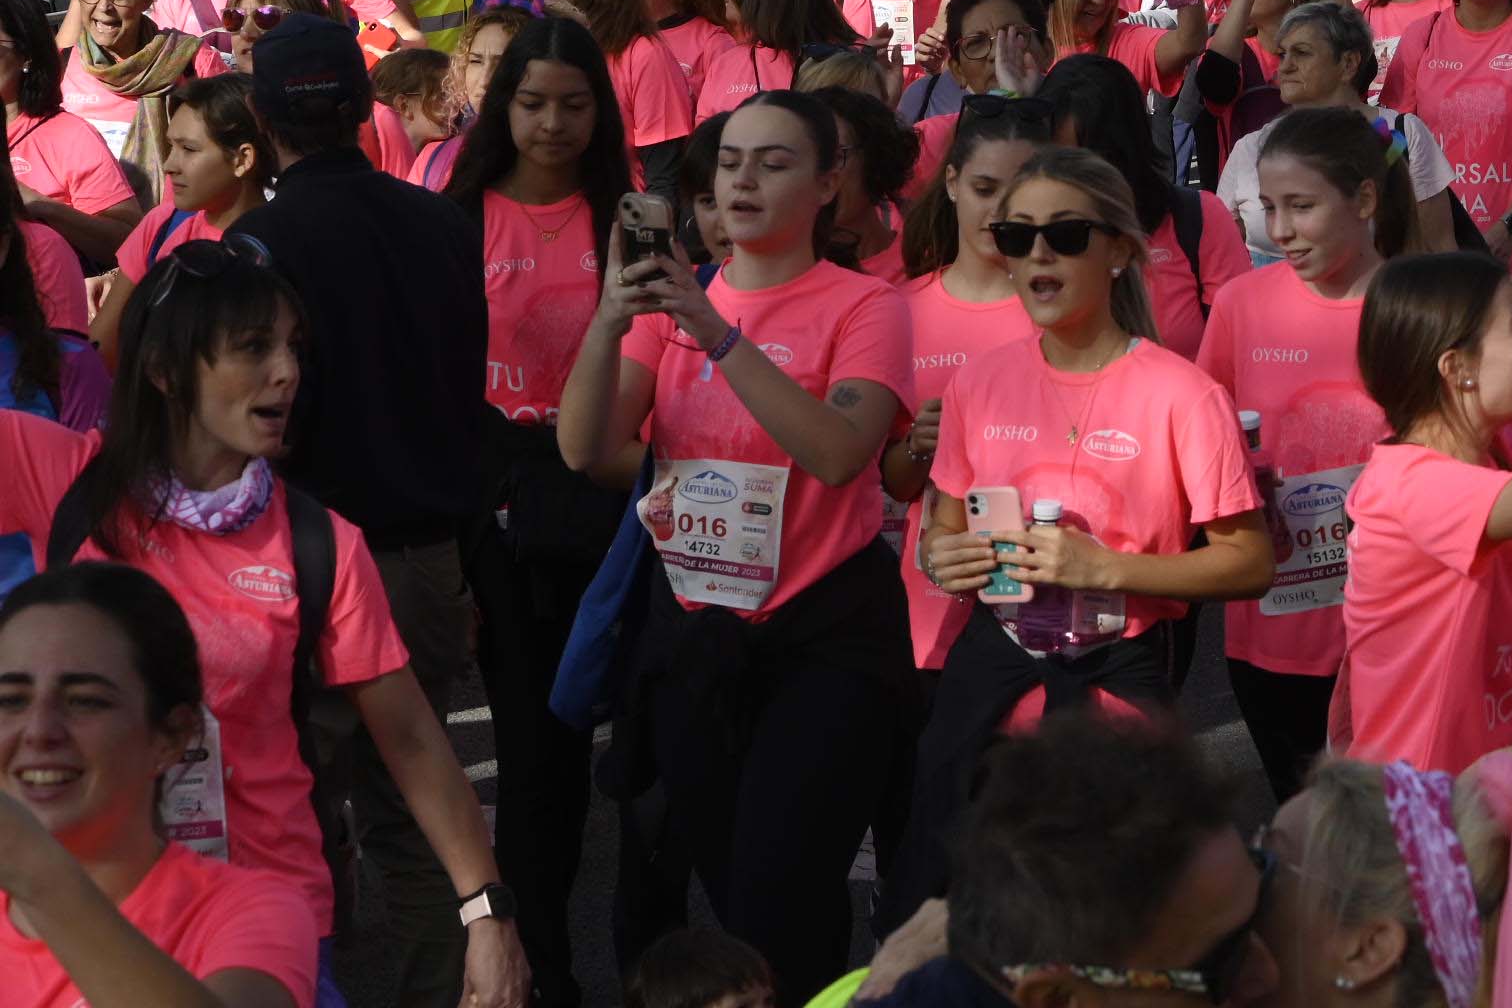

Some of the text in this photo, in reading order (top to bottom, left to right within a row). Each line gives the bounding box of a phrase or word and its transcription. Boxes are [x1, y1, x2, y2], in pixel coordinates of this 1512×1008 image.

[1455, 162, 1512, 185] RSAL
[1252, 347, 1308, 364] OYSHO
[488, 361, 524, 393] TU
[984, 425, 1038, 442] OYSHO
[681, 482, 732, 498] ASTURIANA
[678, 513, 727, 537] 016
[1296, 523, 1344, 547] 016
[1307, 548, 1344, 564] 15132
[684, 560, 696, 568] DE
[698, 560, 710, 568] LA
[712, 563, 739, 574] MUJER
[1312, 570, 1324, 578] DE
[1273, 590, 1315, 605] OYSHO
